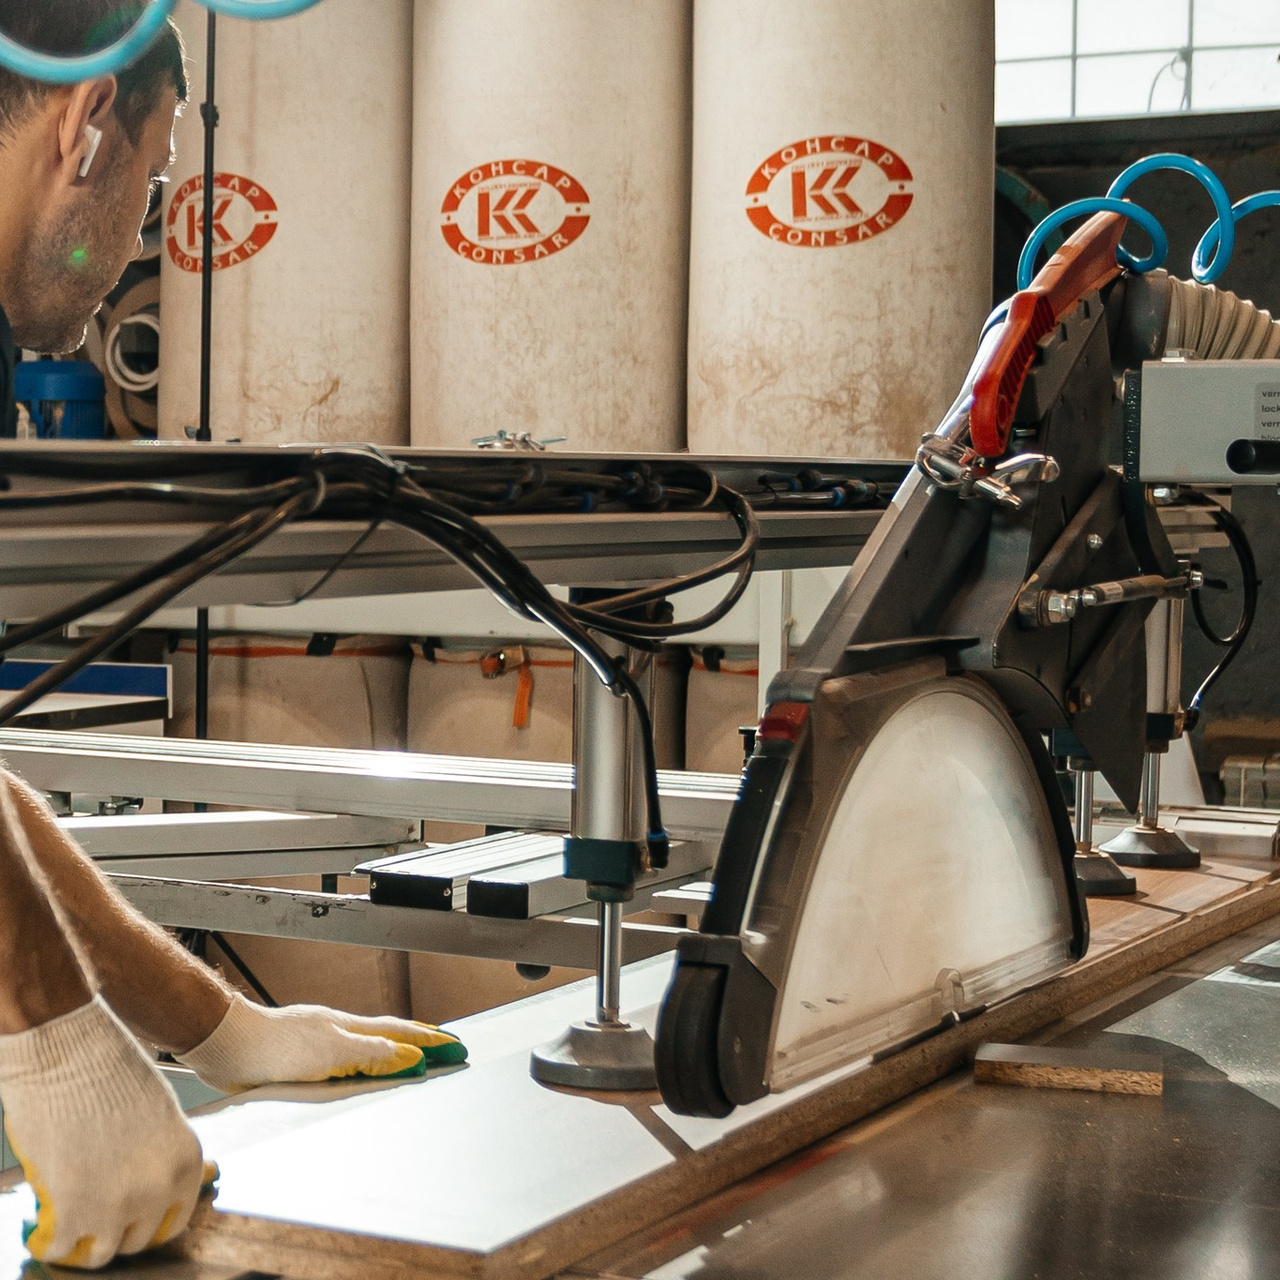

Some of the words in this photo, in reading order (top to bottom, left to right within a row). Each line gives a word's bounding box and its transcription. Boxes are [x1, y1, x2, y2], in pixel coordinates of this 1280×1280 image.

[761, 137, 894, 180] КОНСАР
[452, 160, 571, 200] КОНСАР
[768, 212, 894, 247] CONSAR
[457, 233, 569, 264] CONSAR
